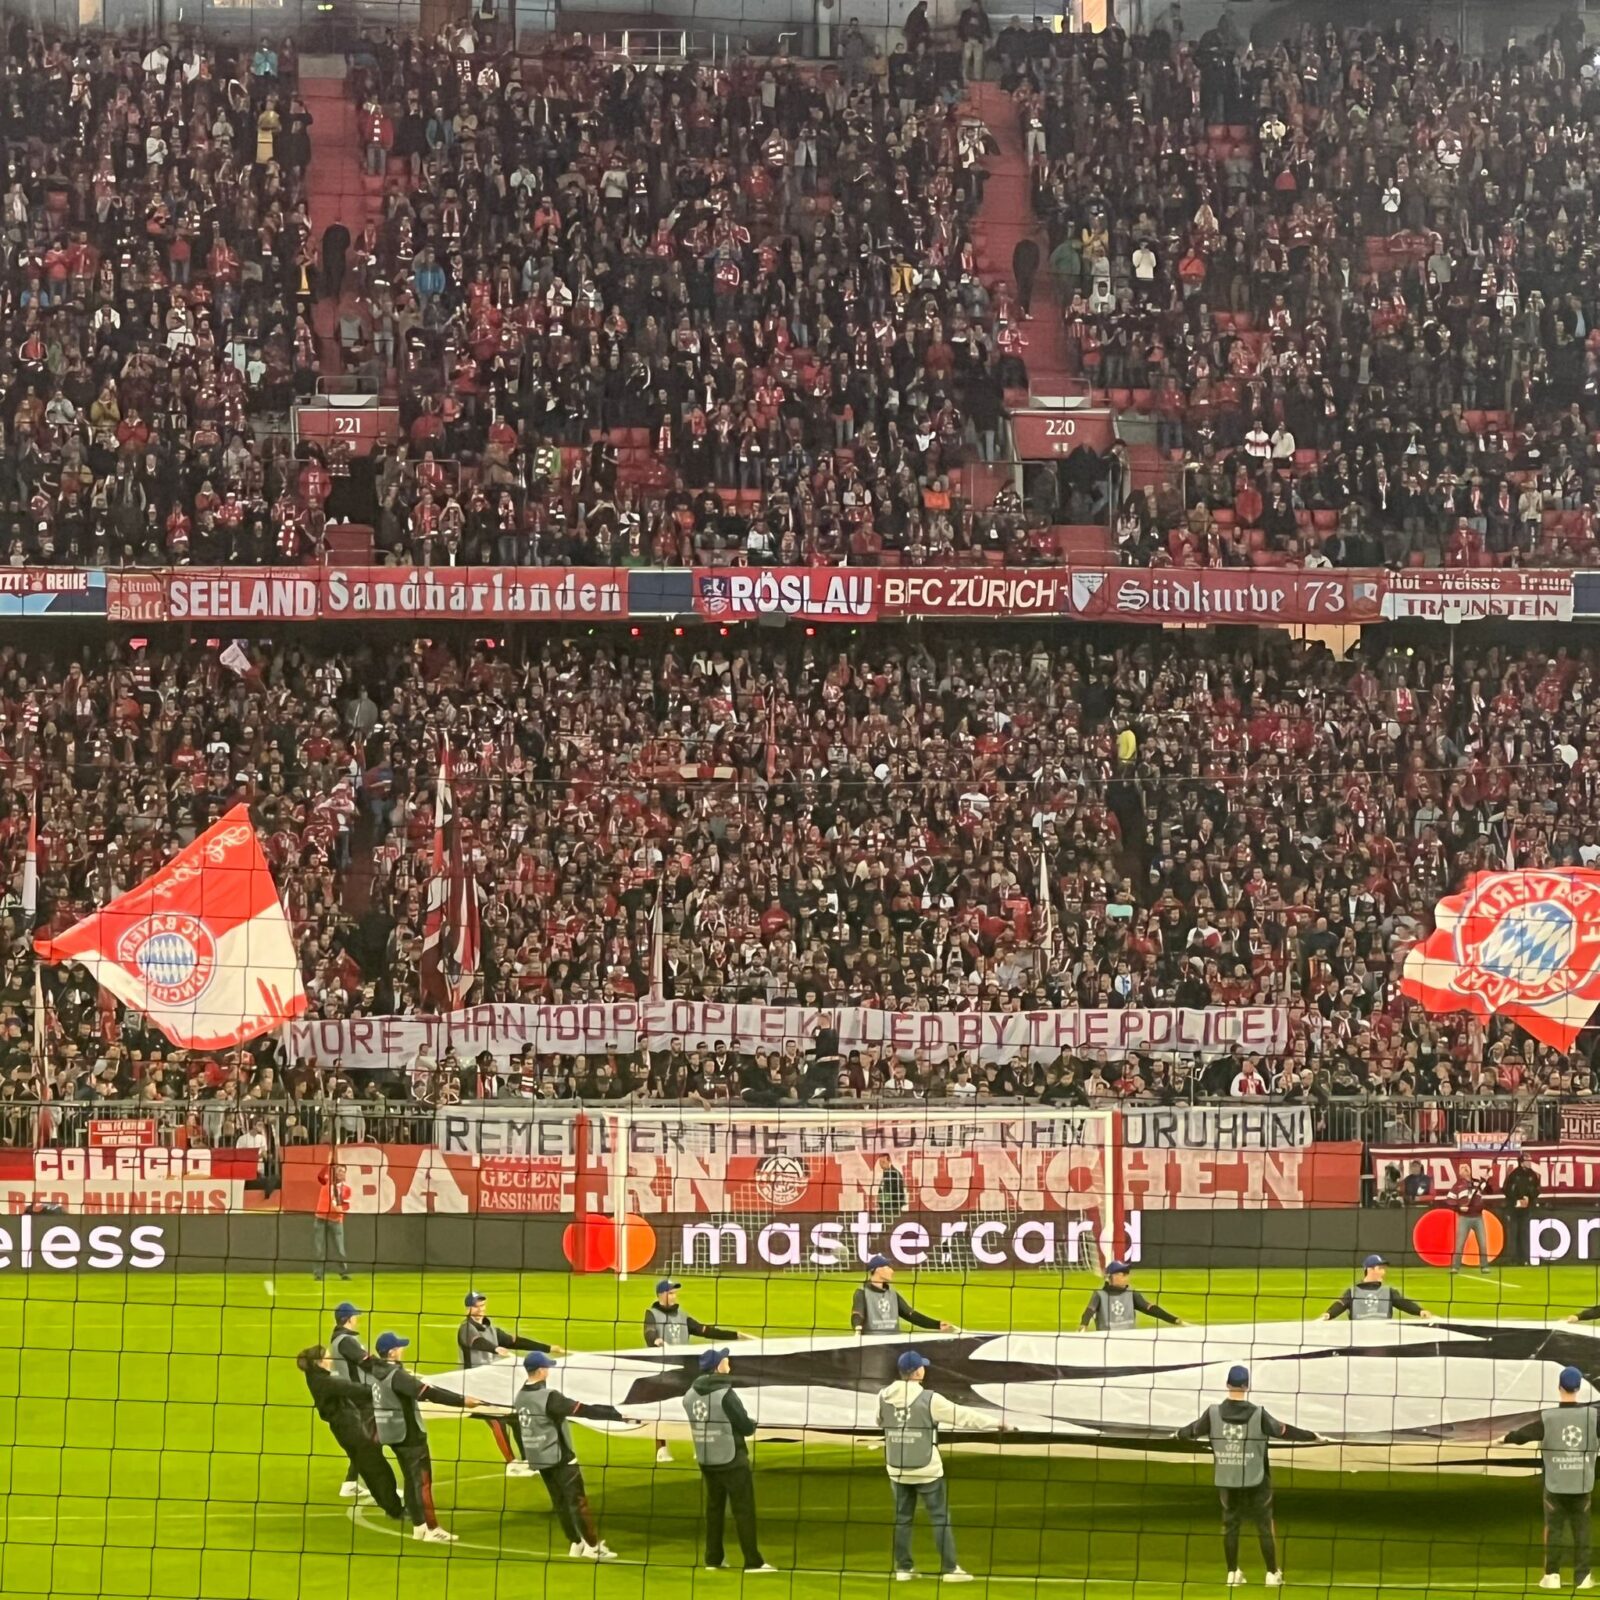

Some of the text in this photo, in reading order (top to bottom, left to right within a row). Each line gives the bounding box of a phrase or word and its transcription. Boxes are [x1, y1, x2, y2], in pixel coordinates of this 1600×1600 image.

[335, 418, 361, 435] 221
[1045, 419, 1075, 436] 220
[170, 580, 316, 617] SEELAND
[328, 570, 621, 612] Sandharlanden
[730, 571, 872, 615] RÖSLAU
[884, 575, 1056, 607] BFC ZÜRICH
[1117, 579, 1345, 613] Südkurve '73
[290, 999, 1284, 1056] MORE THAN 100 PEOPLE KLLED BY THE POLICE!
[329, 1147, 731, 1213] BAERN
[480, 1167, 561, 1188] GEGEN
[480, 1190, 561, 1211] RASSISMUS
[682, 1210, 1141, 1266] mastercard
[1529, 1217, 1600, 1266] pr
